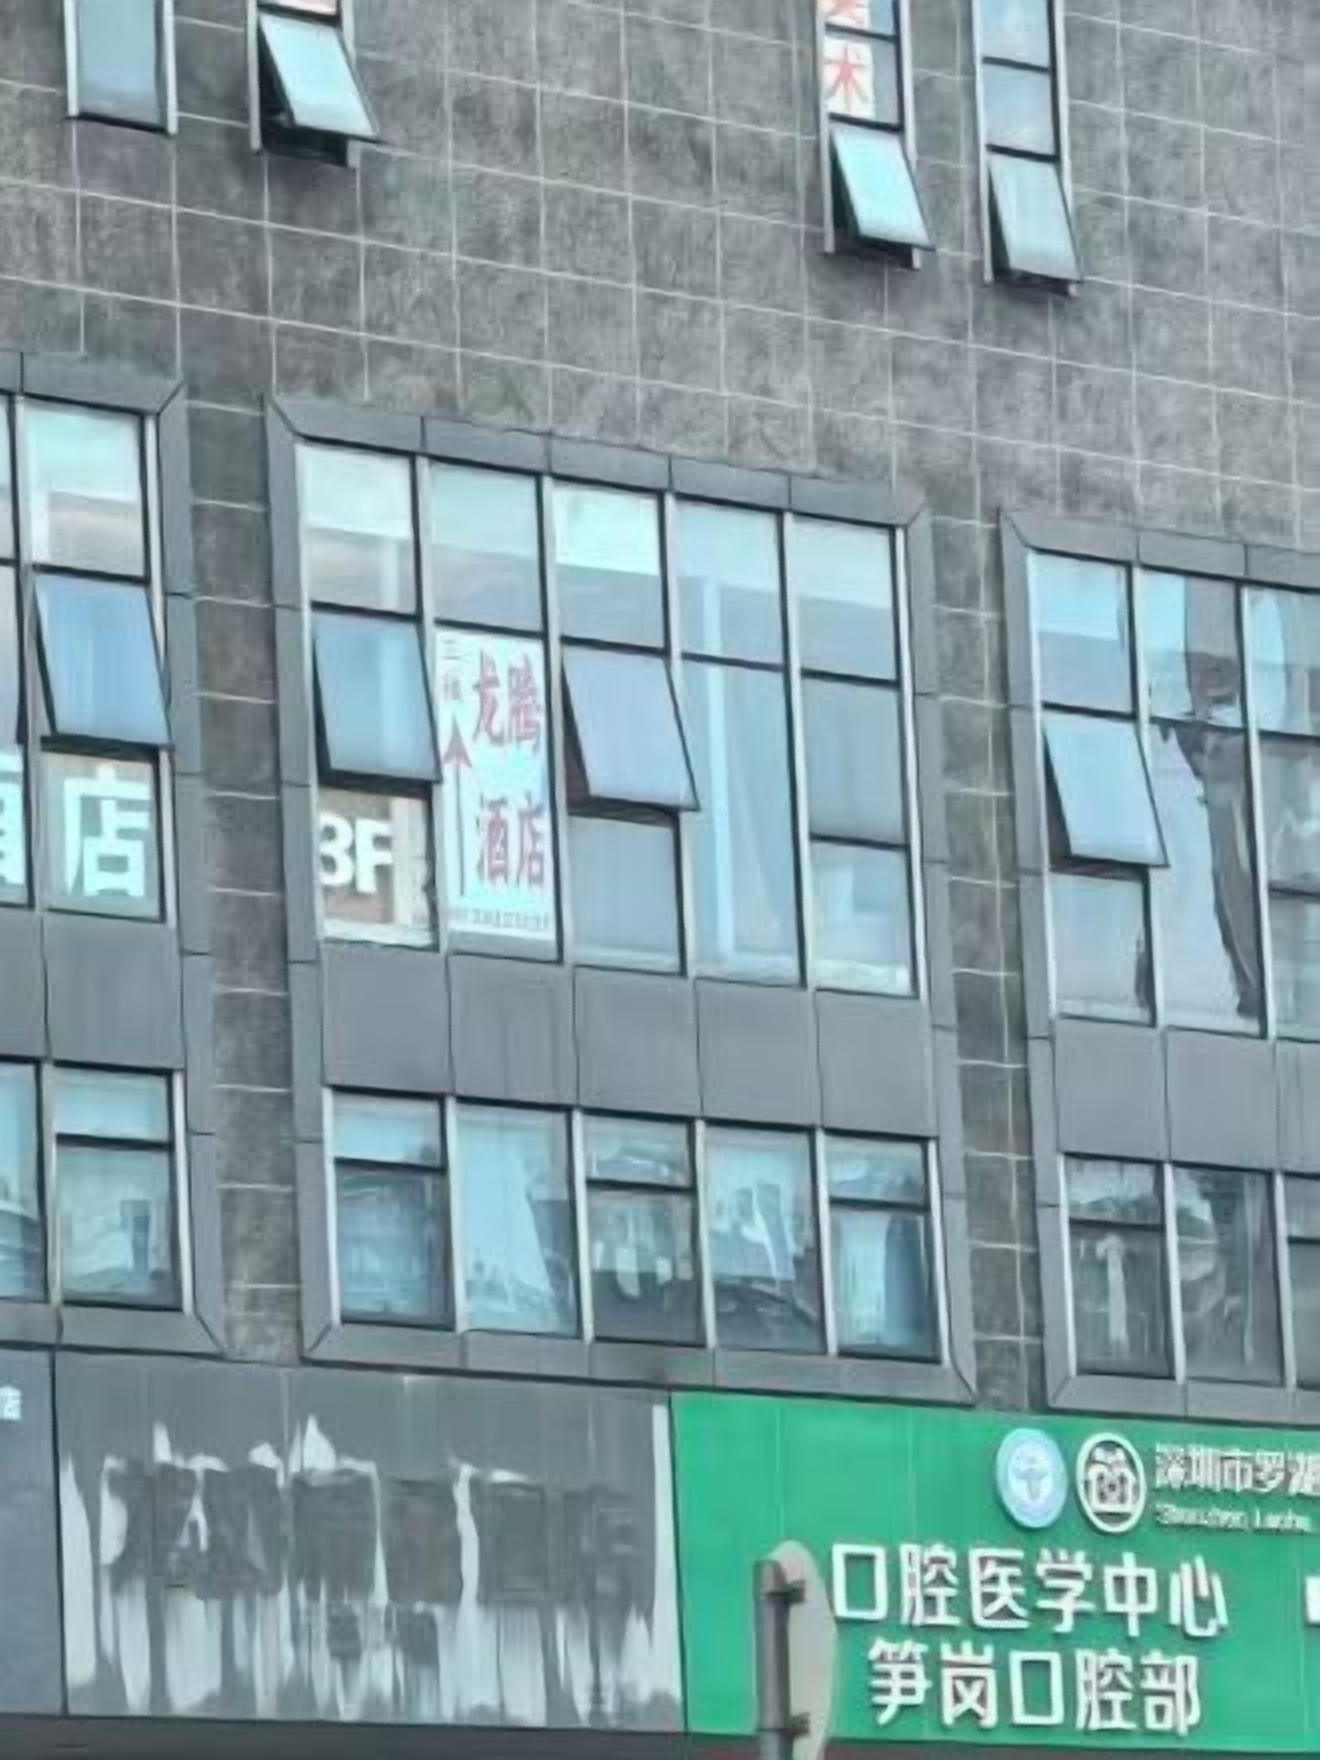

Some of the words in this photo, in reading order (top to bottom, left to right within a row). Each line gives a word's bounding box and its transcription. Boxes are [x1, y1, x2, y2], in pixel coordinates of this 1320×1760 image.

[831, 1543, 1229, 1638] 口腔医学中心
[868, 1638, 1201, 1736] 笋岗口腔部
